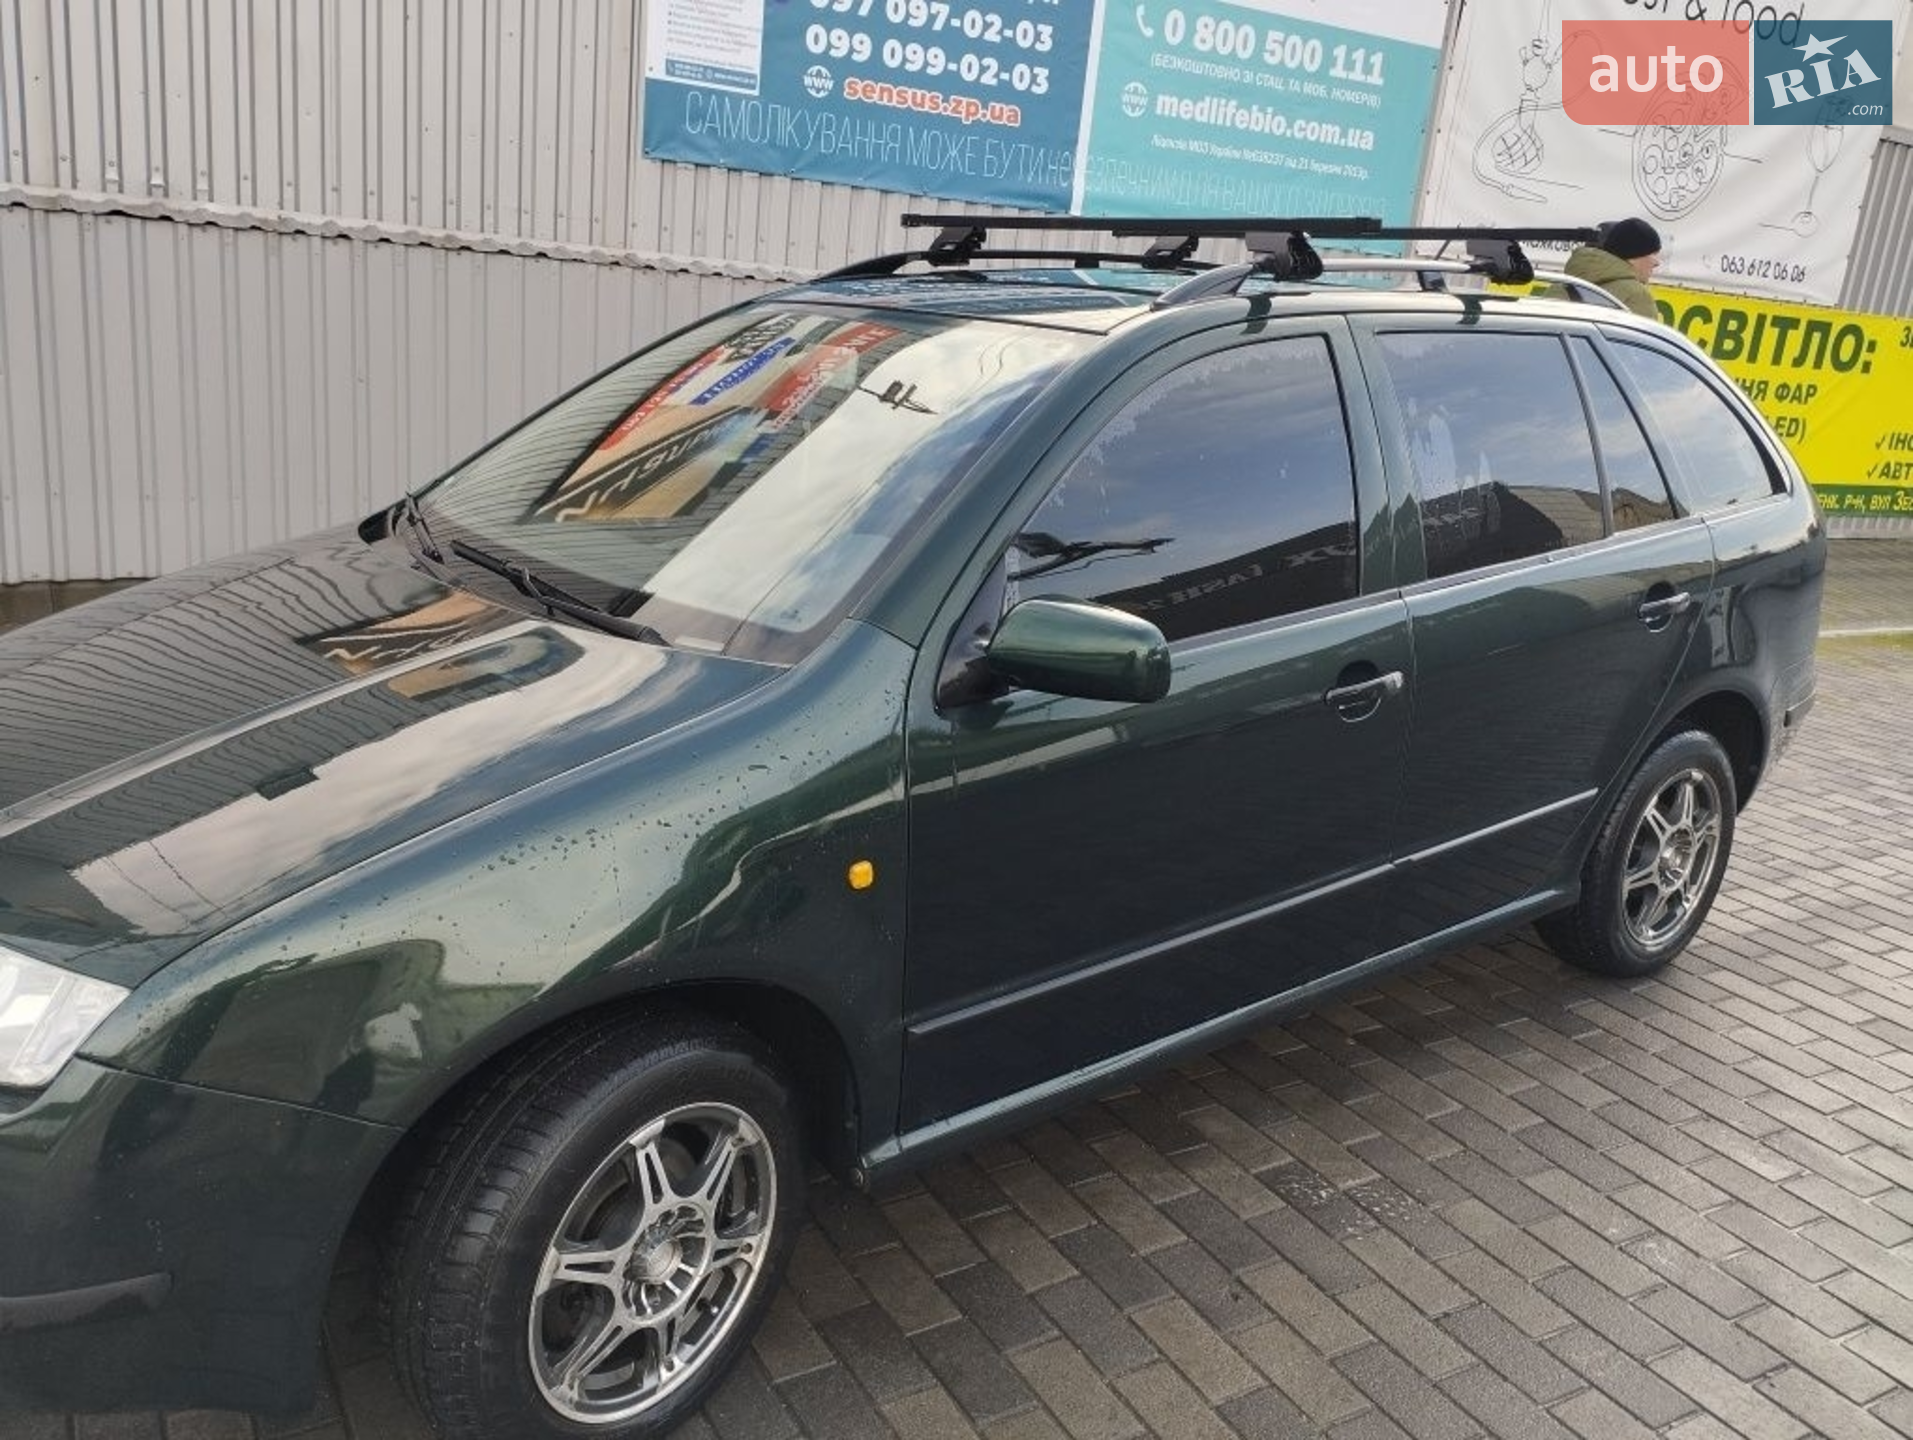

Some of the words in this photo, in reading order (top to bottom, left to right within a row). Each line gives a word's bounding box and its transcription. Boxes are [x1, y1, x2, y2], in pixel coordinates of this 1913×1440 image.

[886, 0, 1054, 51] 097-02-03
[1164, 8, 1186, 46] 0
[1193, 16, 1256, 60] 800
[1263, 30, 1323, 74] 500
[1329, 43, 1385, 86] 111
[805, 24, 872, 62] 099
[883, 39, 1050, 94] 099-02-03
[843, 76, 1022, 126] sensus.zp.ua
[1155, 93, 1375, 152] medlifebio.com.ua
[685, 91, 900, 163] САМОЛІКУВАННЯ
[907, 126, 978, 176] МОЖЕ
[984, 139, 1047, 181] БУТИ
[1721, 254, 1745, 275] 063
[1747, 259, 1771, 278] 612
[1774, 262, 1788, 280] 06
[1790, 265, 1806, 283] 06
[1735, 377, 1769, 402] НЯ
[1774, 381, 1818, 406] ФАР
[1765, 415, 1807, 445] ED)
